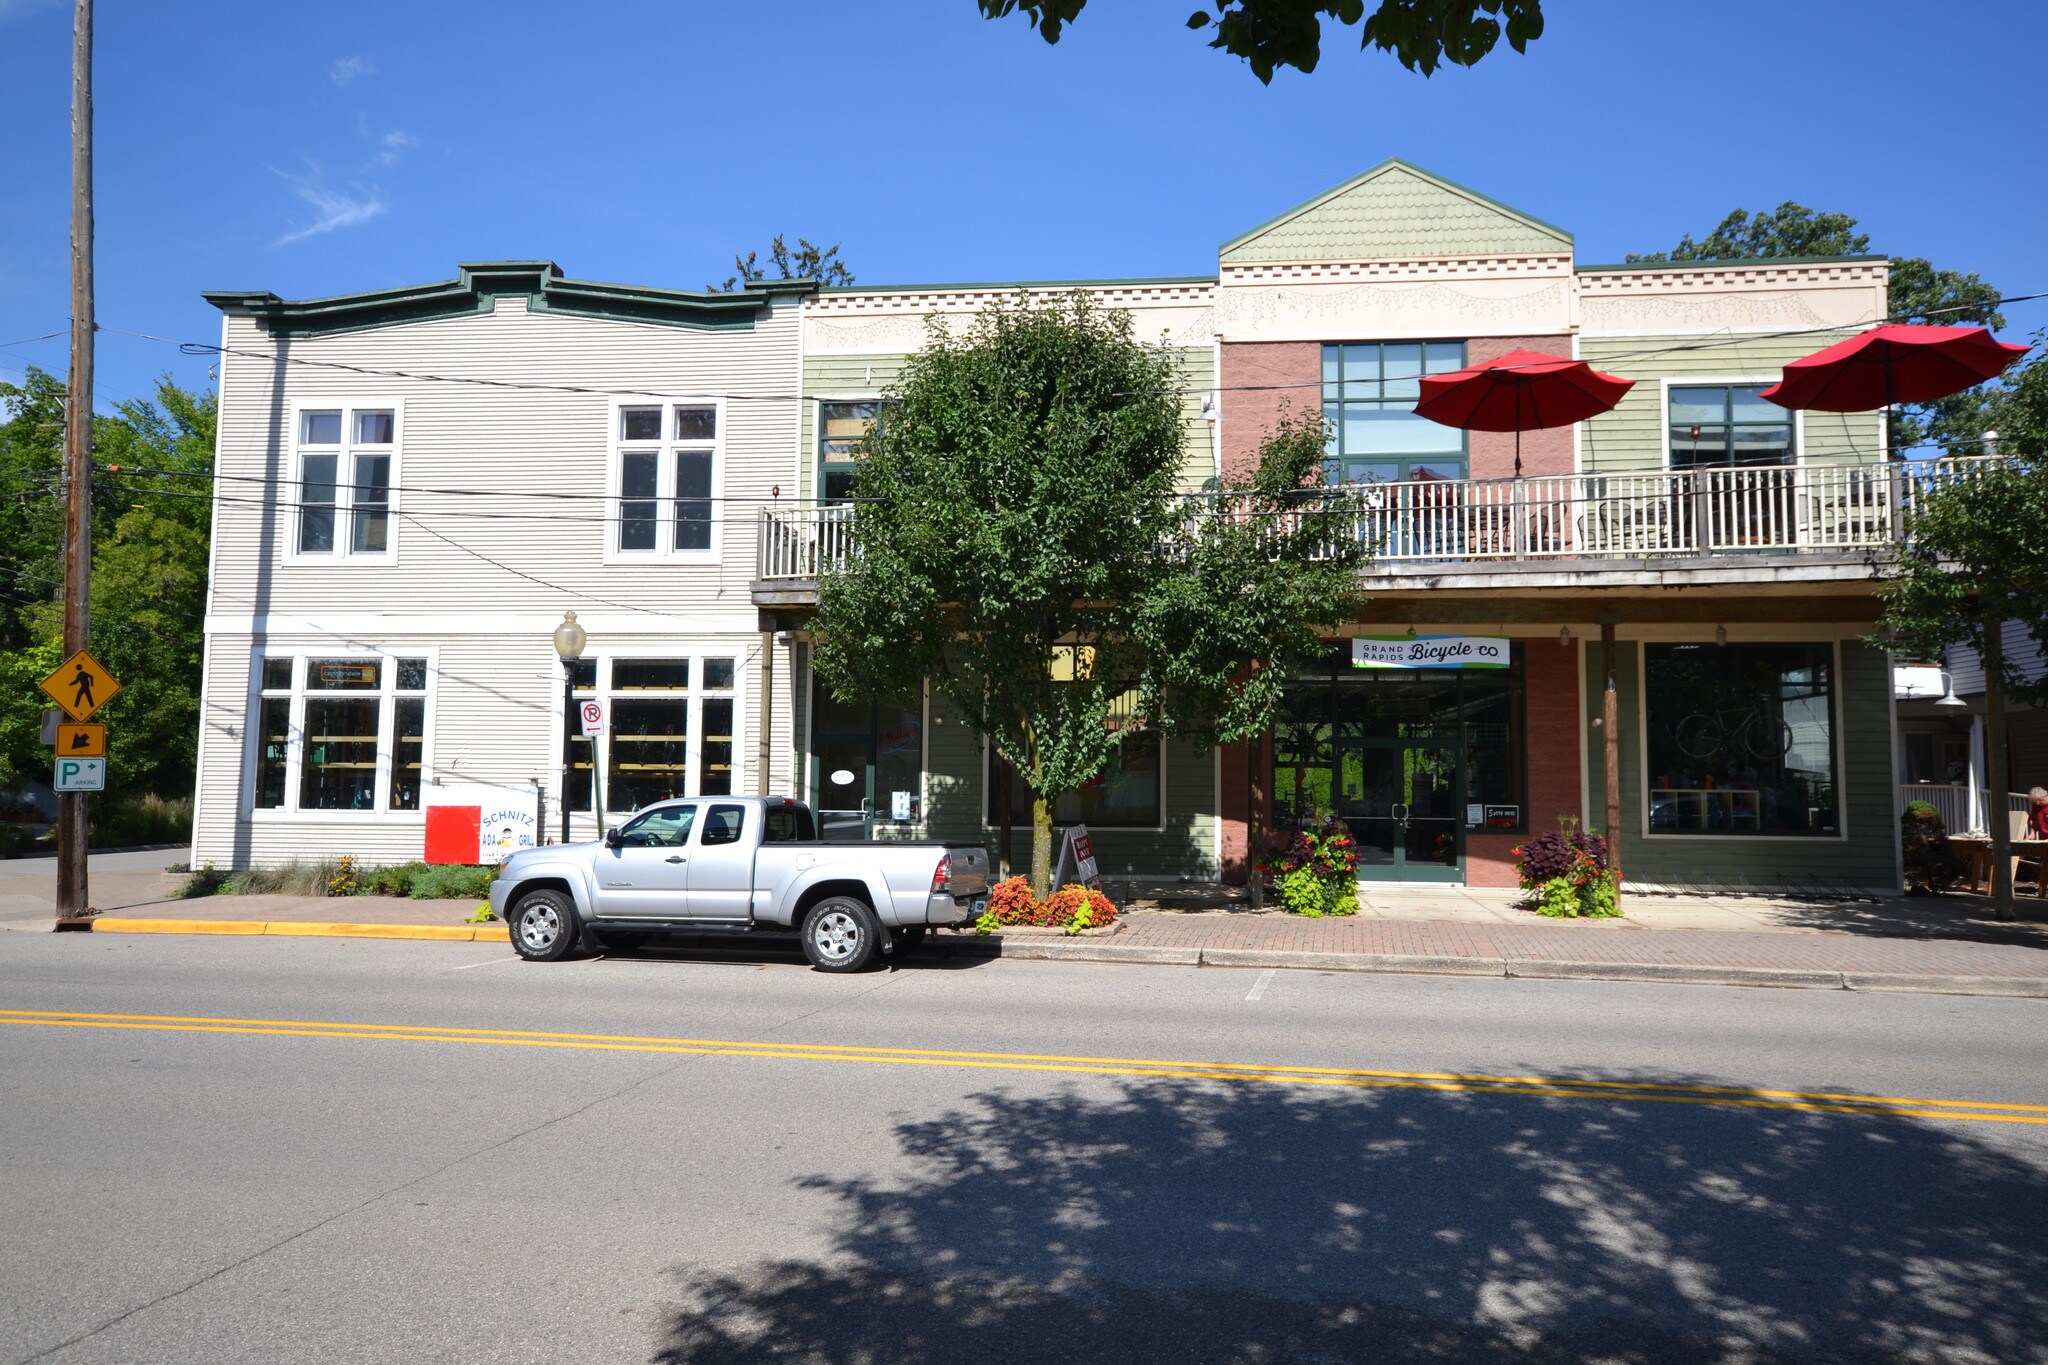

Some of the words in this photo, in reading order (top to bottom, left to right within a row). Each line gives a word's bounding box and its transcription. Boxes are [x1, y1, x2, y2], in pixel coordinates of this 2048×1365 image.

[1363, 644, 1404, 653] GRAND
[1408, 642, 1473, 662] Bicycle
[1363, 652, 1404, 661] RAPIDS
[482, 810, 535, 828] SCHNITZ
[482, 834, 496, 846] ADA
[518, 834, 535, 846] GRILL
